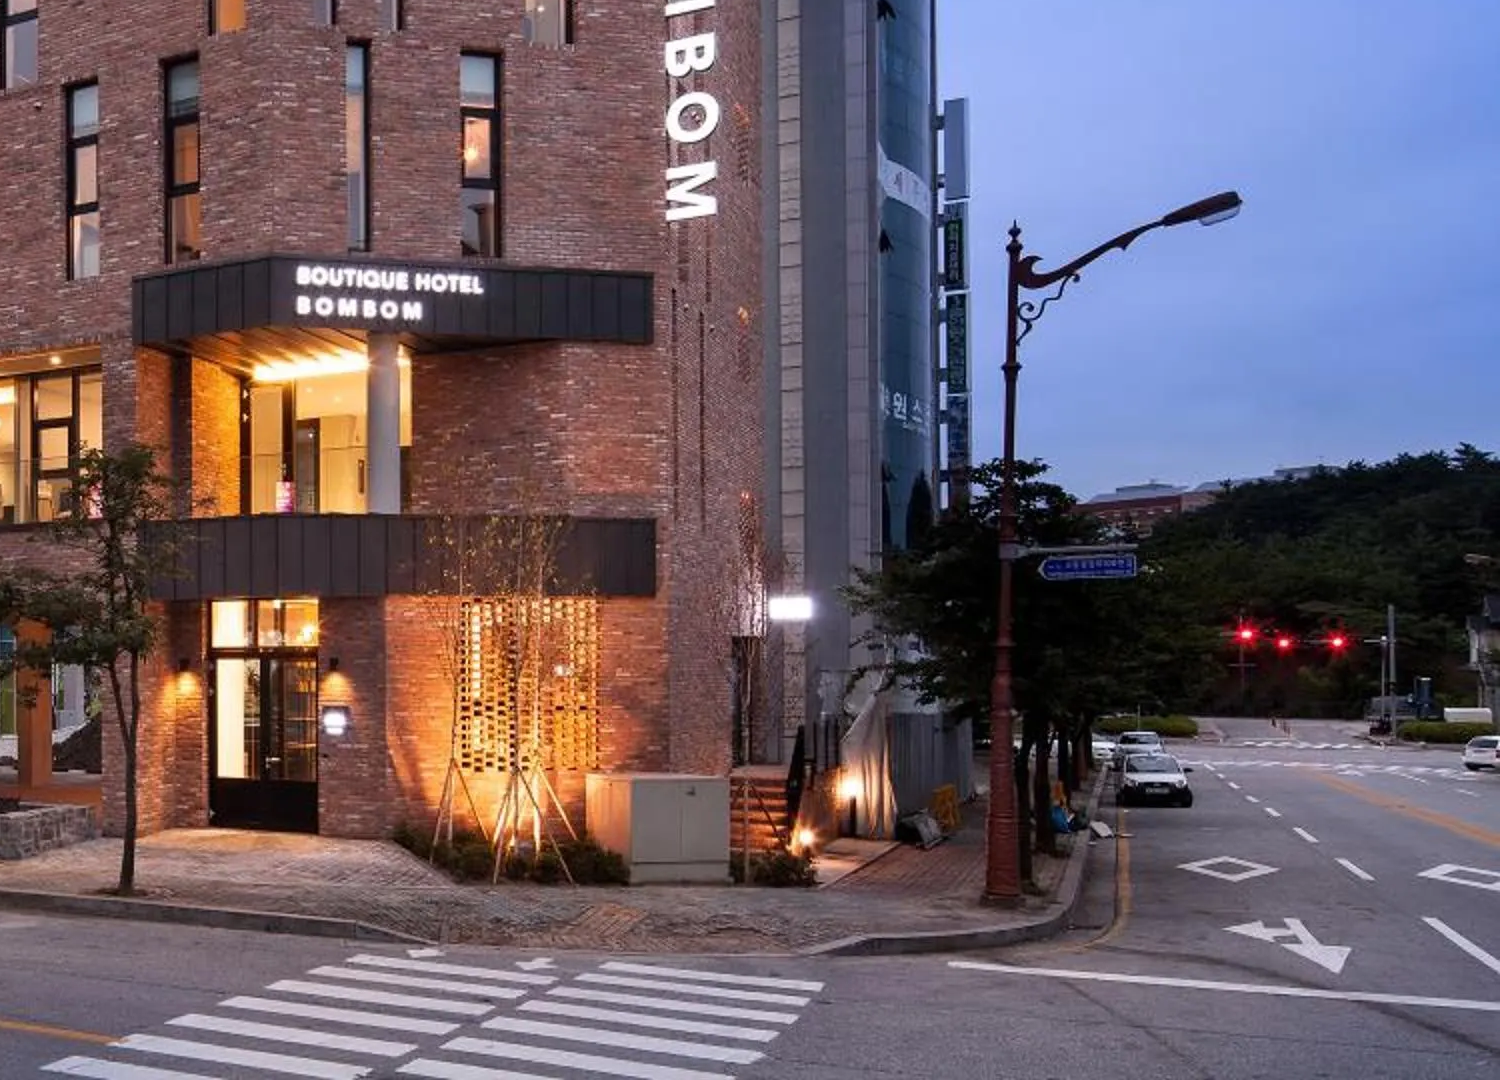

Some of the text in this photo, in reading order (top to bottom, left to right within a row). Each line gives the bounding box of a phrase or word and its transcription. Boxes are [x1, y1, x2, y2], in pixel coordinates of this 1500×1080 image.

[295, 265, 485, 295] BOUTIQUE HOTEL
[295, 295, 424, 320] BOMBOM
